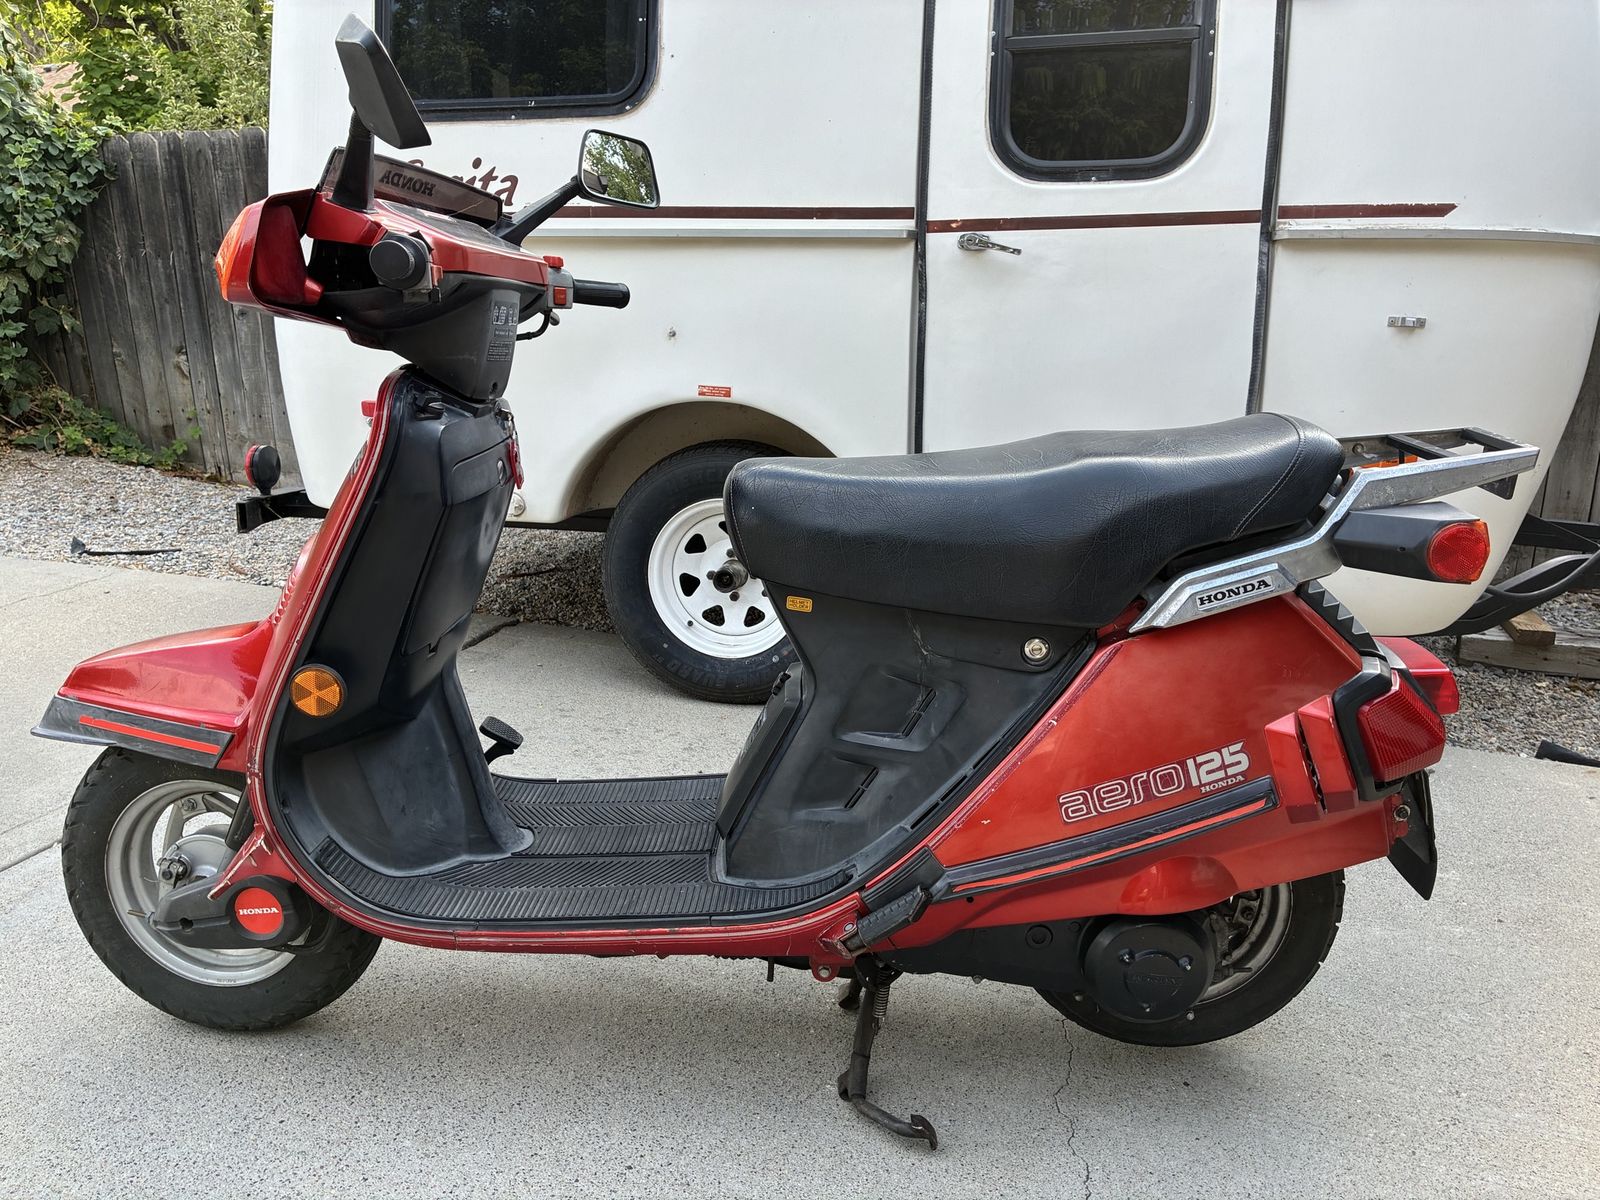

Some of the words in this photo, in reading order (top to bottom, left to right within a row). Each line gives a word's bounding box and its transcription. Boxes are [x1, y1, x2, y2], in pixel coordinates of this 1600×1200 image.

[1198, 579, 1271, 606] HONDA
[1059, 763, 1185, 822] aero
[1186, 741, 1250, 787] 125
[1200, 775, 1246, 794] HONDA
[238, 907, 279, 915] HONDA
